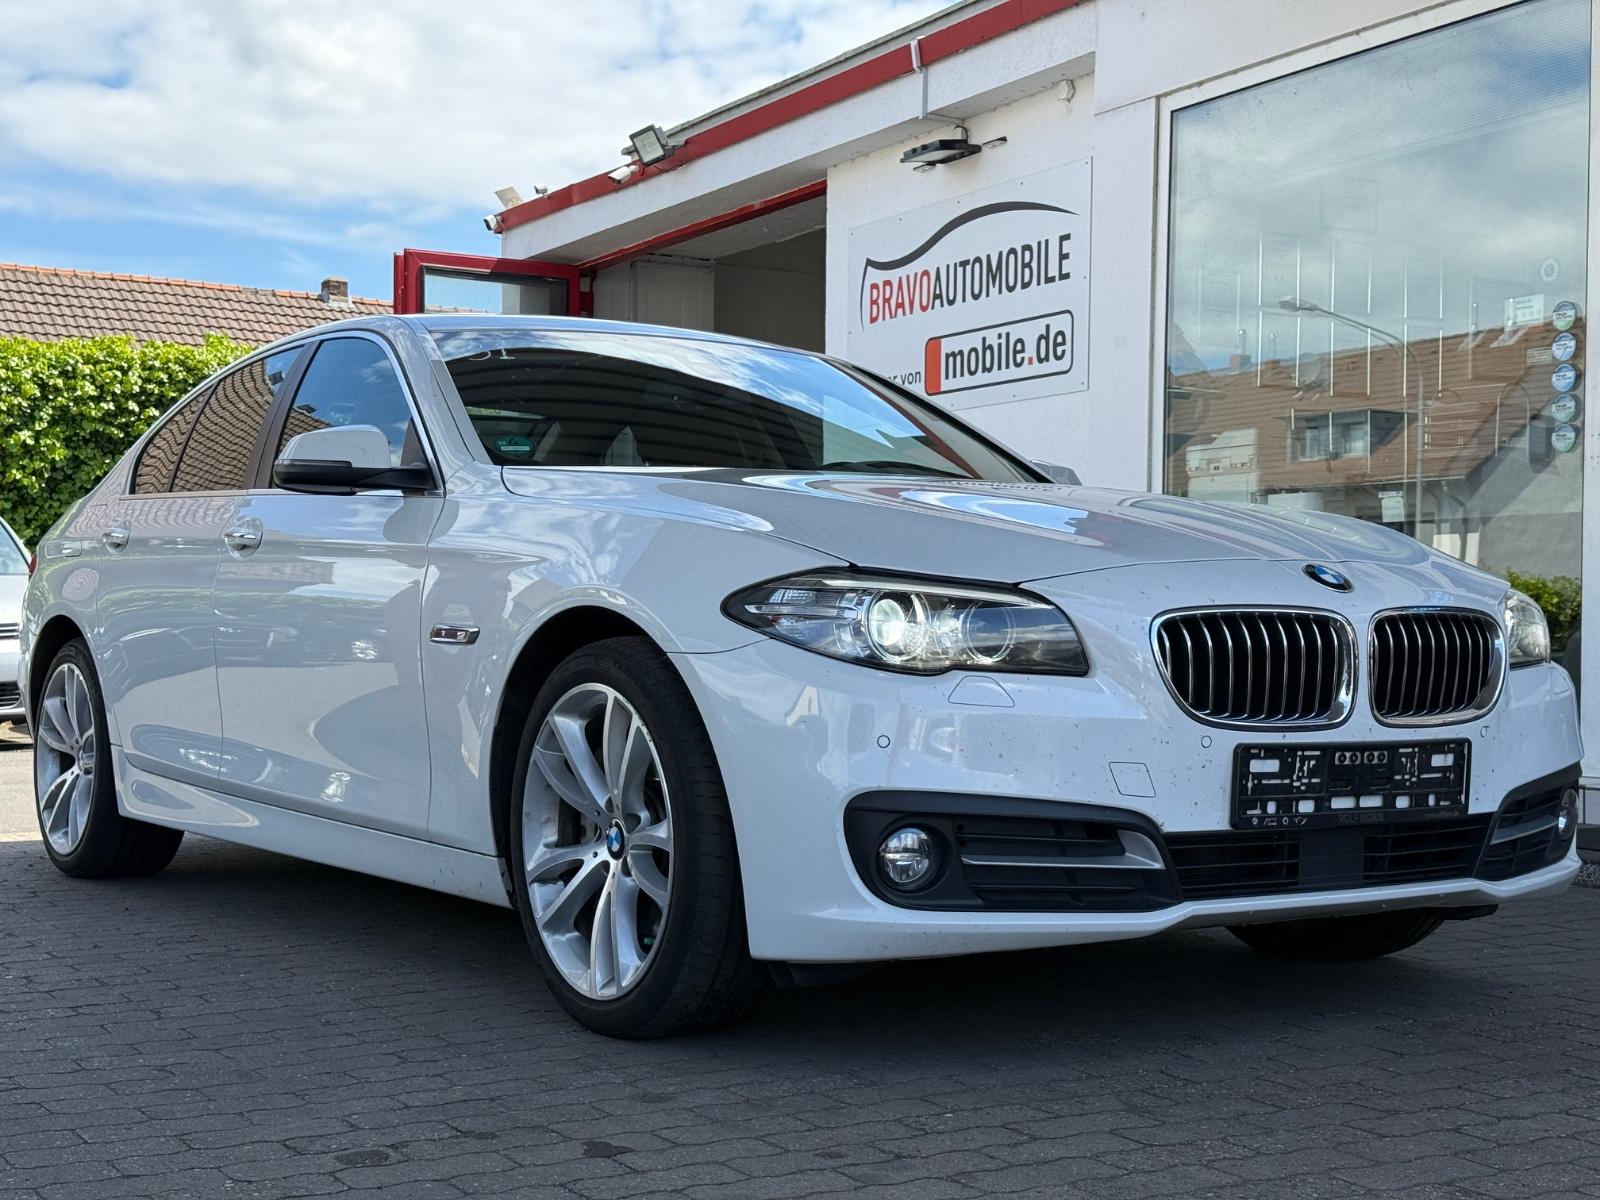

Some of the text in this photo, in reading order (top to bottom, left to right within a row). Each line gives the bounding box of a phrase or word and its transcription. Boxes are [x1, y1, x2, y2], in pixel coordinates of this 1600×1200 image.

[869, 233, 1071, 324] BRAVOAUTOMOBILE
[900, 371, 921, 385] von
[944, 323, 1067, 380] mobile.de
